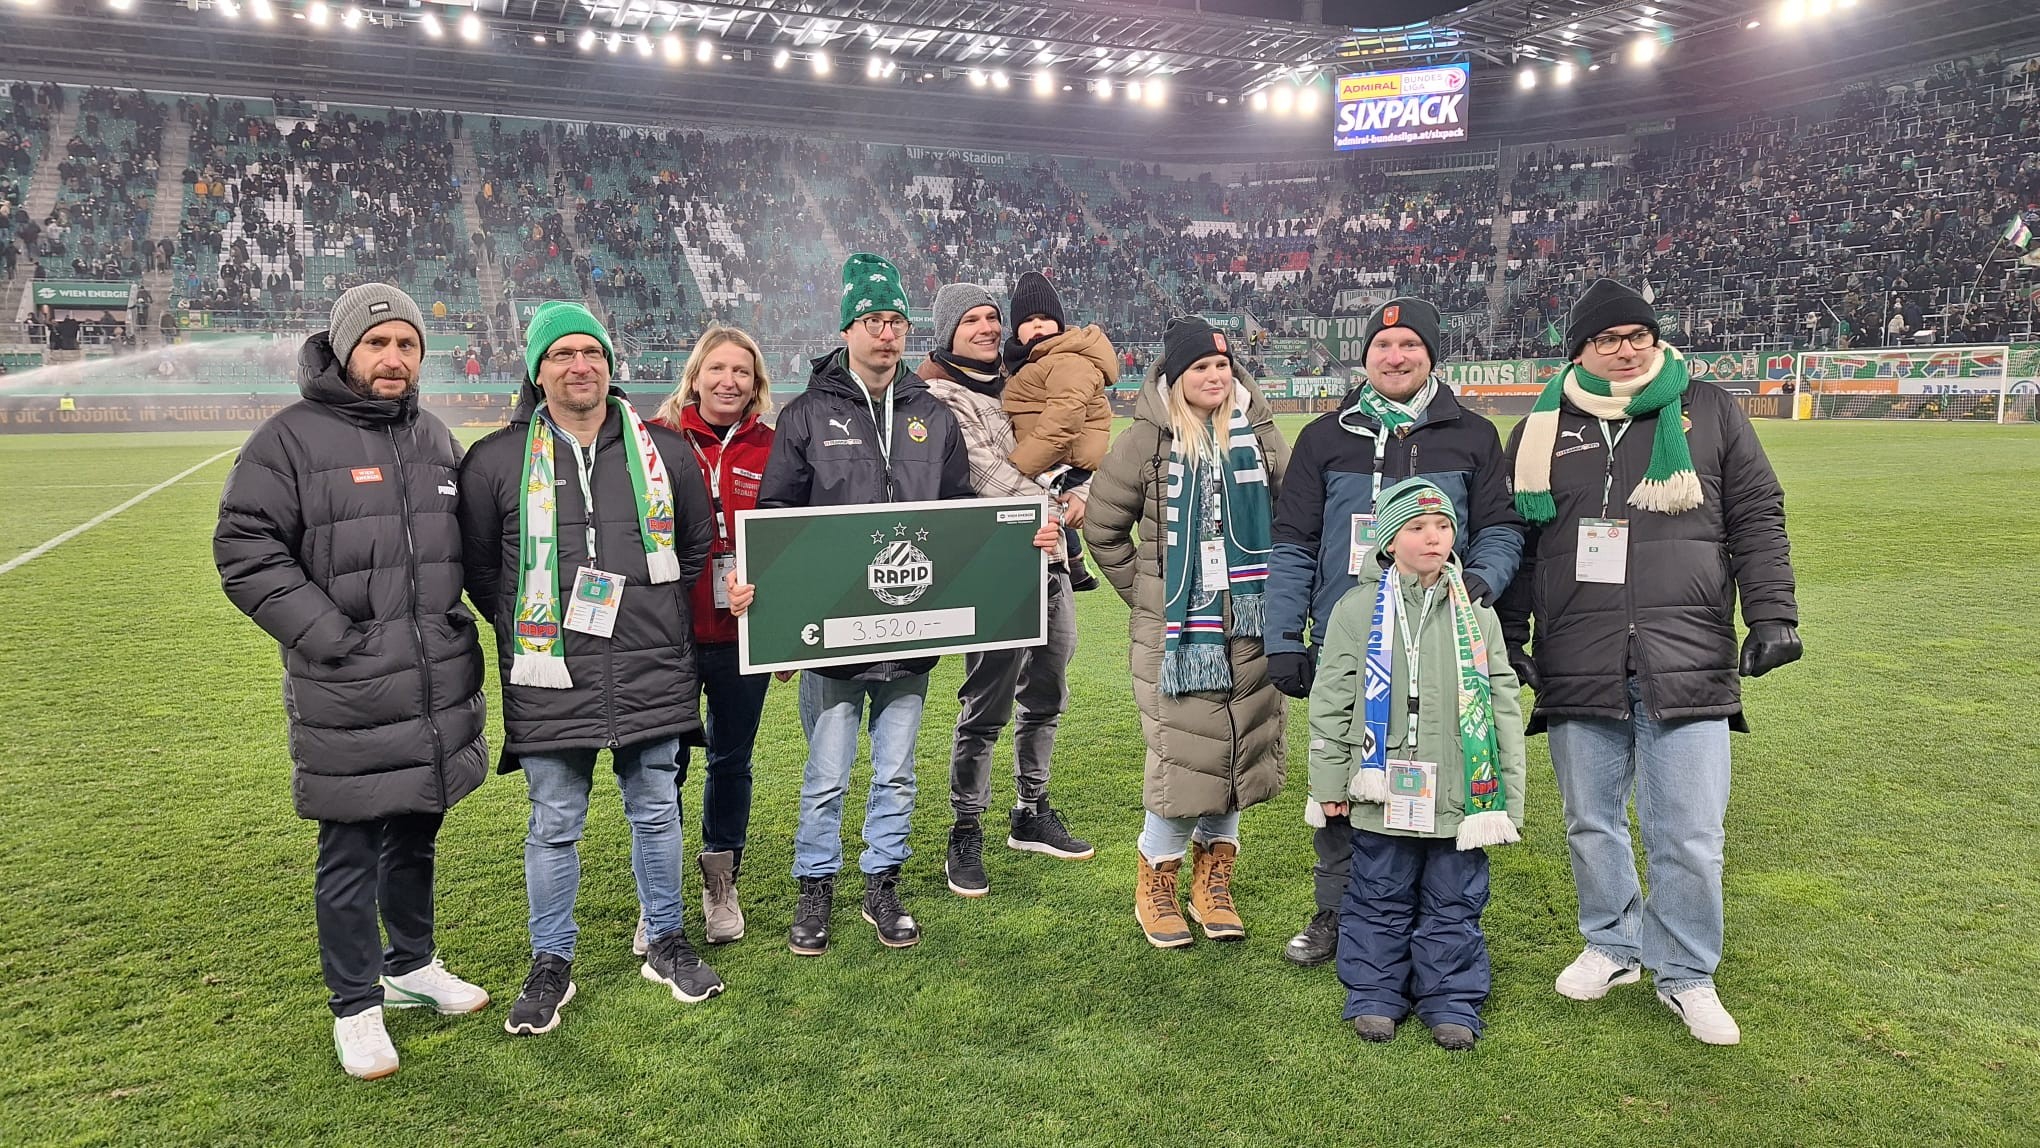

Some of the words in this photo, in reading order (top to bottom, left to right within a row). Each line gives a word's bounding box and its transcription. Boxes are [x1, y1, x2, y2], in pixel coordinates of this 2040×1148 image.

[1404, 74, 1443, 84] BUNDES
[1343, 81, 1398, 94] ADMIRAL
[1404, 84, 1425, 92] LIGA
[1338, 94, 1464, 132] SIXPACK
[962, 151, 1005, 165] Stadion
[59, 289, 87, 298] WIEN
[88, 290, 129, 298] ENERGIE
[1204, 317, 1230, 326] llianz
[1336, 318, 1369, 339] TOW
[1446, 364, 1515, 385] LIONS
[1293, 384, 1346, 396] PANTERS
[1748, 397, 1779, 416] FORM
[873, 565, 929, 585] RAPID
[800, 623, 821, 646] €
